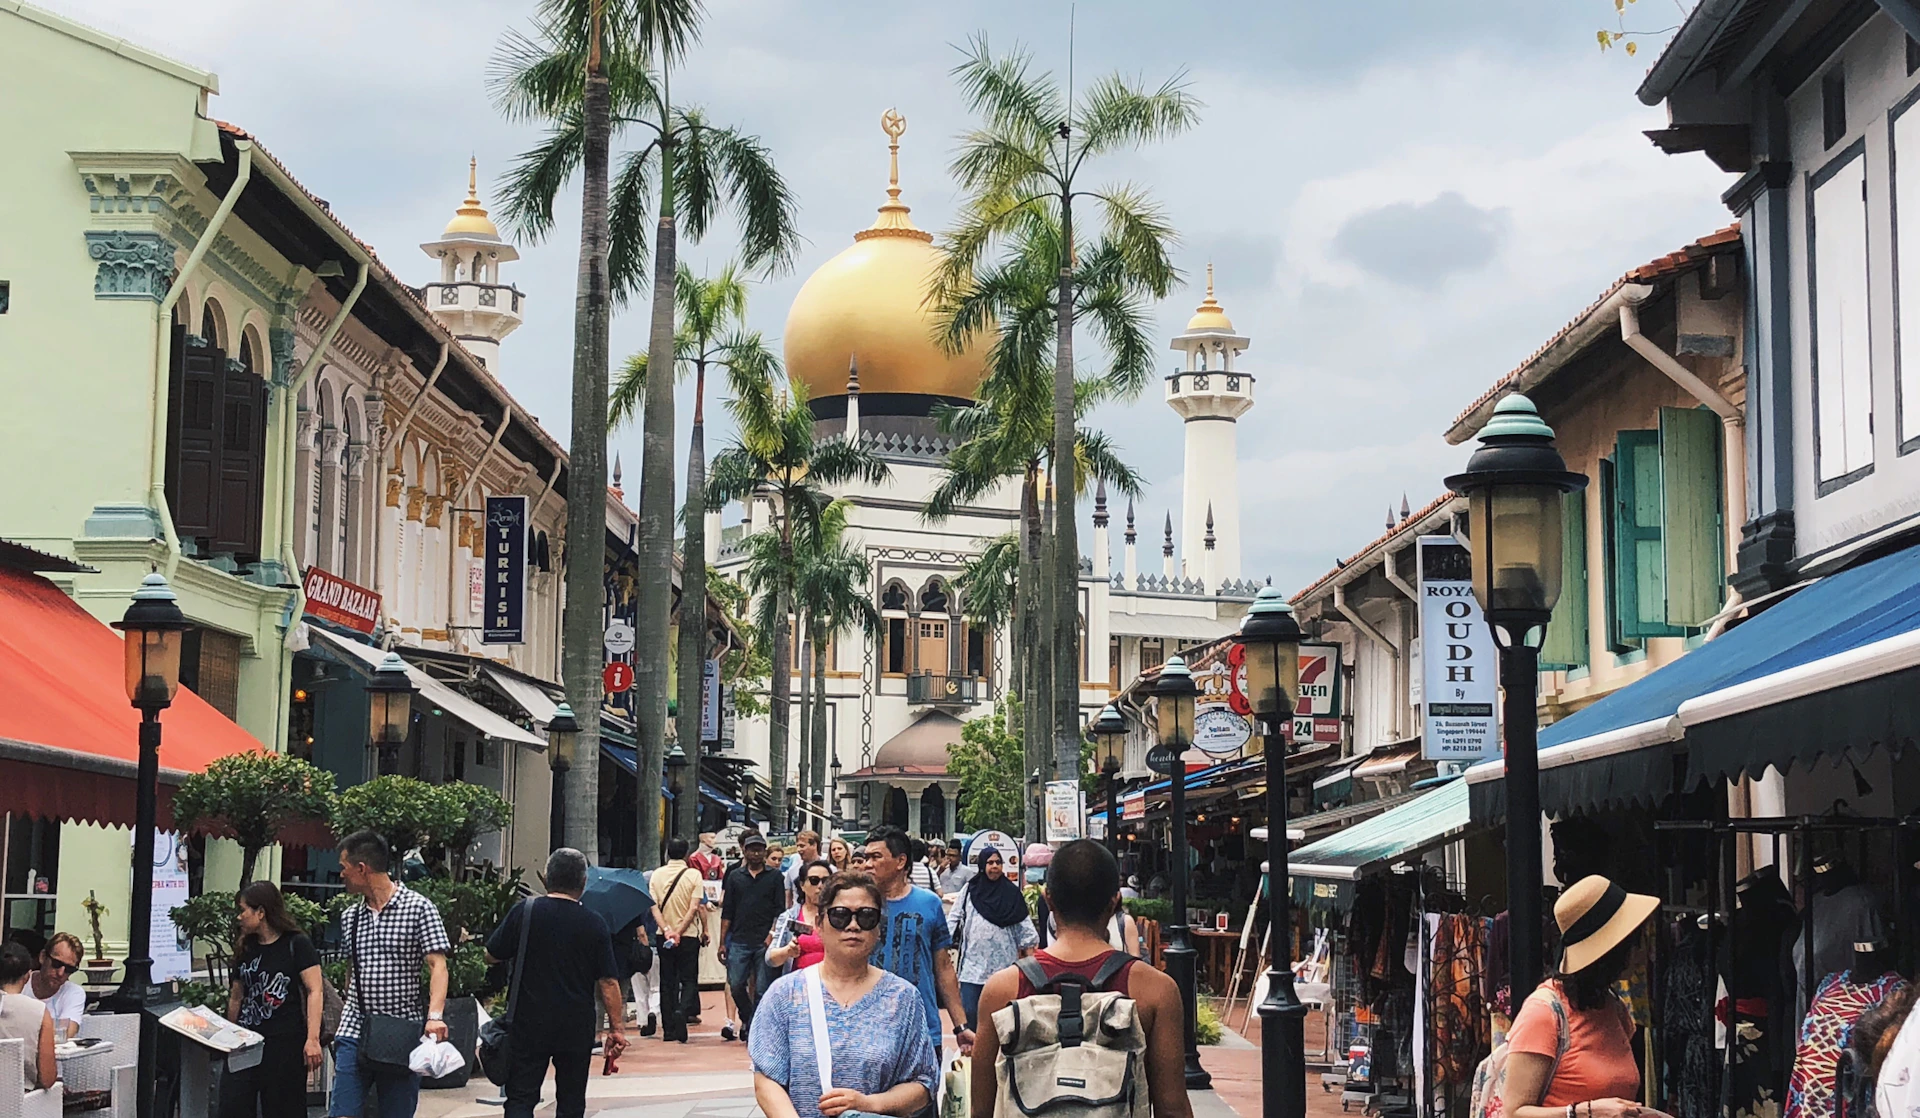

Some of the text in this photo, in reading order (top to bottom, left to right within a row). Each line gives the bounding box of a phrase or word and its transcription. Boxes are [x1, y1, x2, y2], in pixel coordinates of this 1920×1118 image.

[496, 528, 510, 628] TURKISH
[1426, 586, 1475, 597] ROYA
[306, 574, 343, 607] GRAND
[339, 586, 378, 622] BAZAAR
[1445, 601, 1474, 683] OUDH
[702, 679, 710, 728] TURKISH
[1455, 688, 1466, 700] By
[1294, 720, 1312, 737] 24
[1315, 723, 1338, 733] HOURS
[1436, 728, 1465, 736] Singapore
